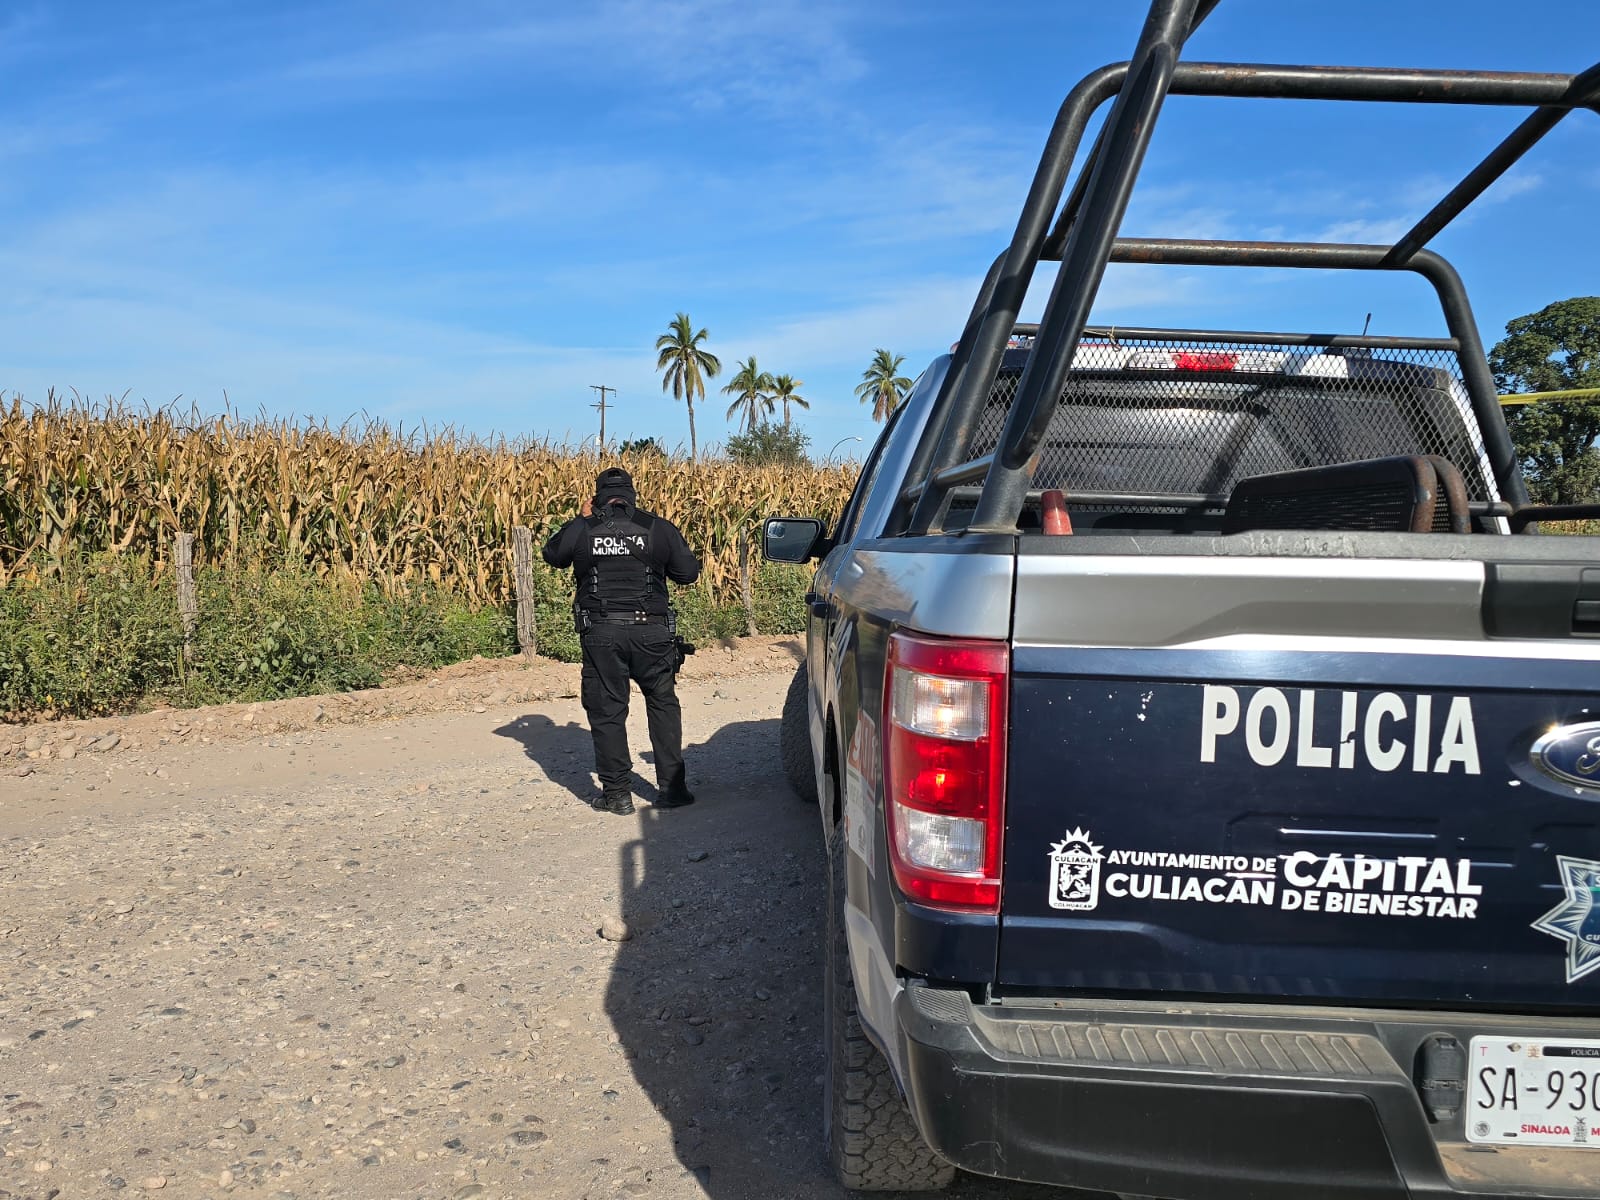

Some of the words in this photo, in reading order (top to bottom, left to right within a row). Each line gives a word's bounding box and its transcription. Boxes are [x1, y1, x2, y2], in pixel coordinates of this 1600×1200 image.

[1200, 684, 1481, 775] POLICIA
[1107, 850, 1249, 871] AYUNTAMIENTO
[1252, 857, 1277, 872] DE
[1284, 851, 1482, 895] CAPITAL
[1281, 889, 1322, 911] DE
[1325, 891, 1479, 919] BIENESTAR
[1520, 1124, 1571, 1135] SINALOA
